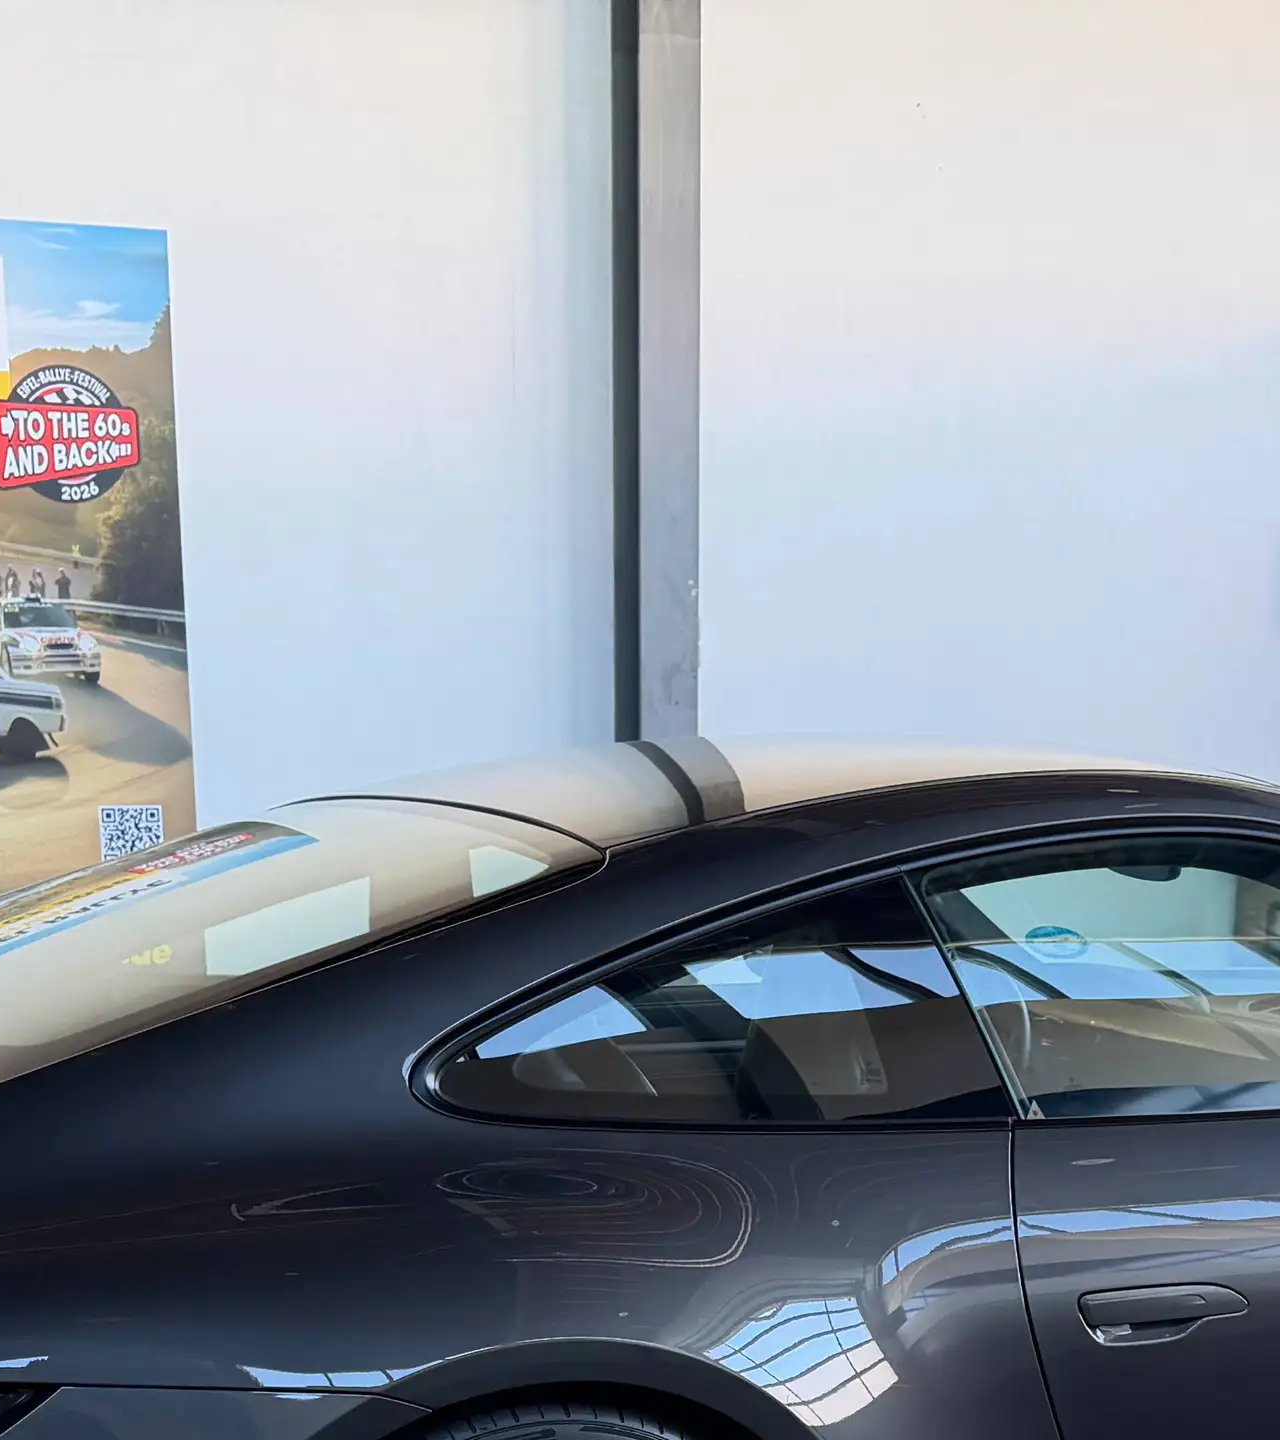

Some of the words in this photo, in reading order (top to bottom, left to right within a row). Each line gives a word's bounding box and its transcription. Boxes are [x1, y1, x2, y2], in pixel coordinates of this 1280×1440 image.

[10, 410, 45, 440] TO
[47, 411, 90, 439] THE
[93, 412, 131, 437] 60s
[3, 444, 49, 479] AND
[53, 440, 112, 472] BACK
[61, 482, 100, 501] 2026
